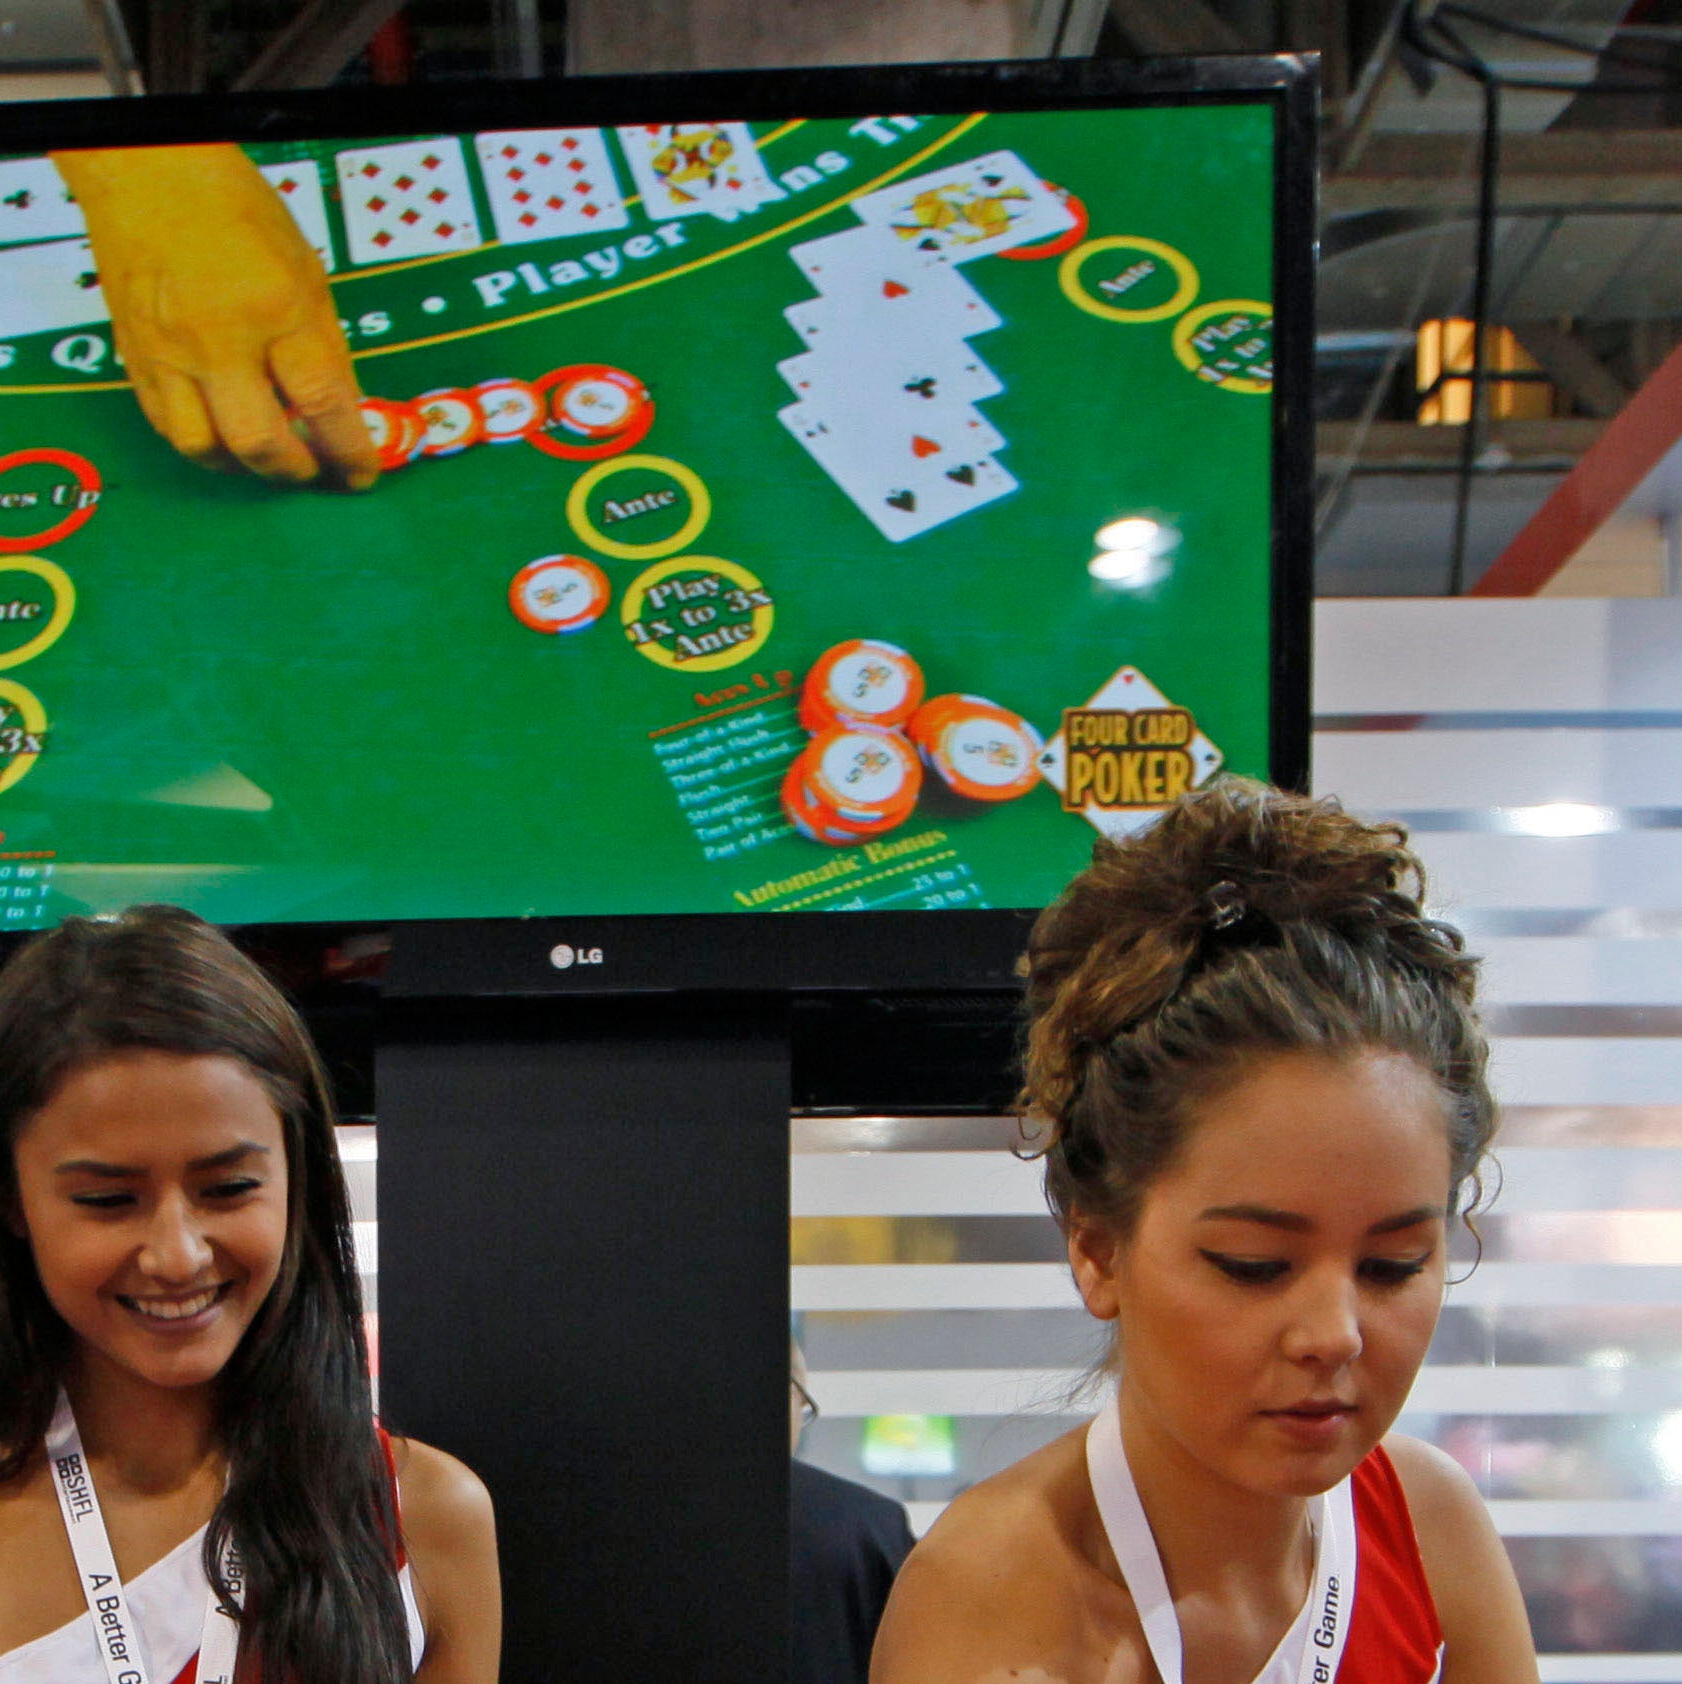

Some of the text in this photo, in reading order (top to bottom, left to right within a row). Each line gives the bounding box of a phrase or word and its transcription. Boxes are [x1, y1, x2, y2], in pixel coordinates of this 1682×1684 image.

[472, 222, 690, 307] Player
[52, 484, 103, 510] Up
[602, 490, 678, 524] Ante
[645, 573, 722, 610] Play
[680, 603, 717, 627] to
[722, 587, 774, 614] 3x
[673, 622, 755, 662] Ante
[1068, 714, 1190, 747] FOUR CARD
[1069, 750, 1195, 805] POKER
[733, 830, 948, 907] Automatic Bonus
[577, 948, 603, 964] LG
[66, 1474, 94, 1524] SHFL
[88, 1572, 113, 1590] A
[96, 1597, 132, 1663] Better
